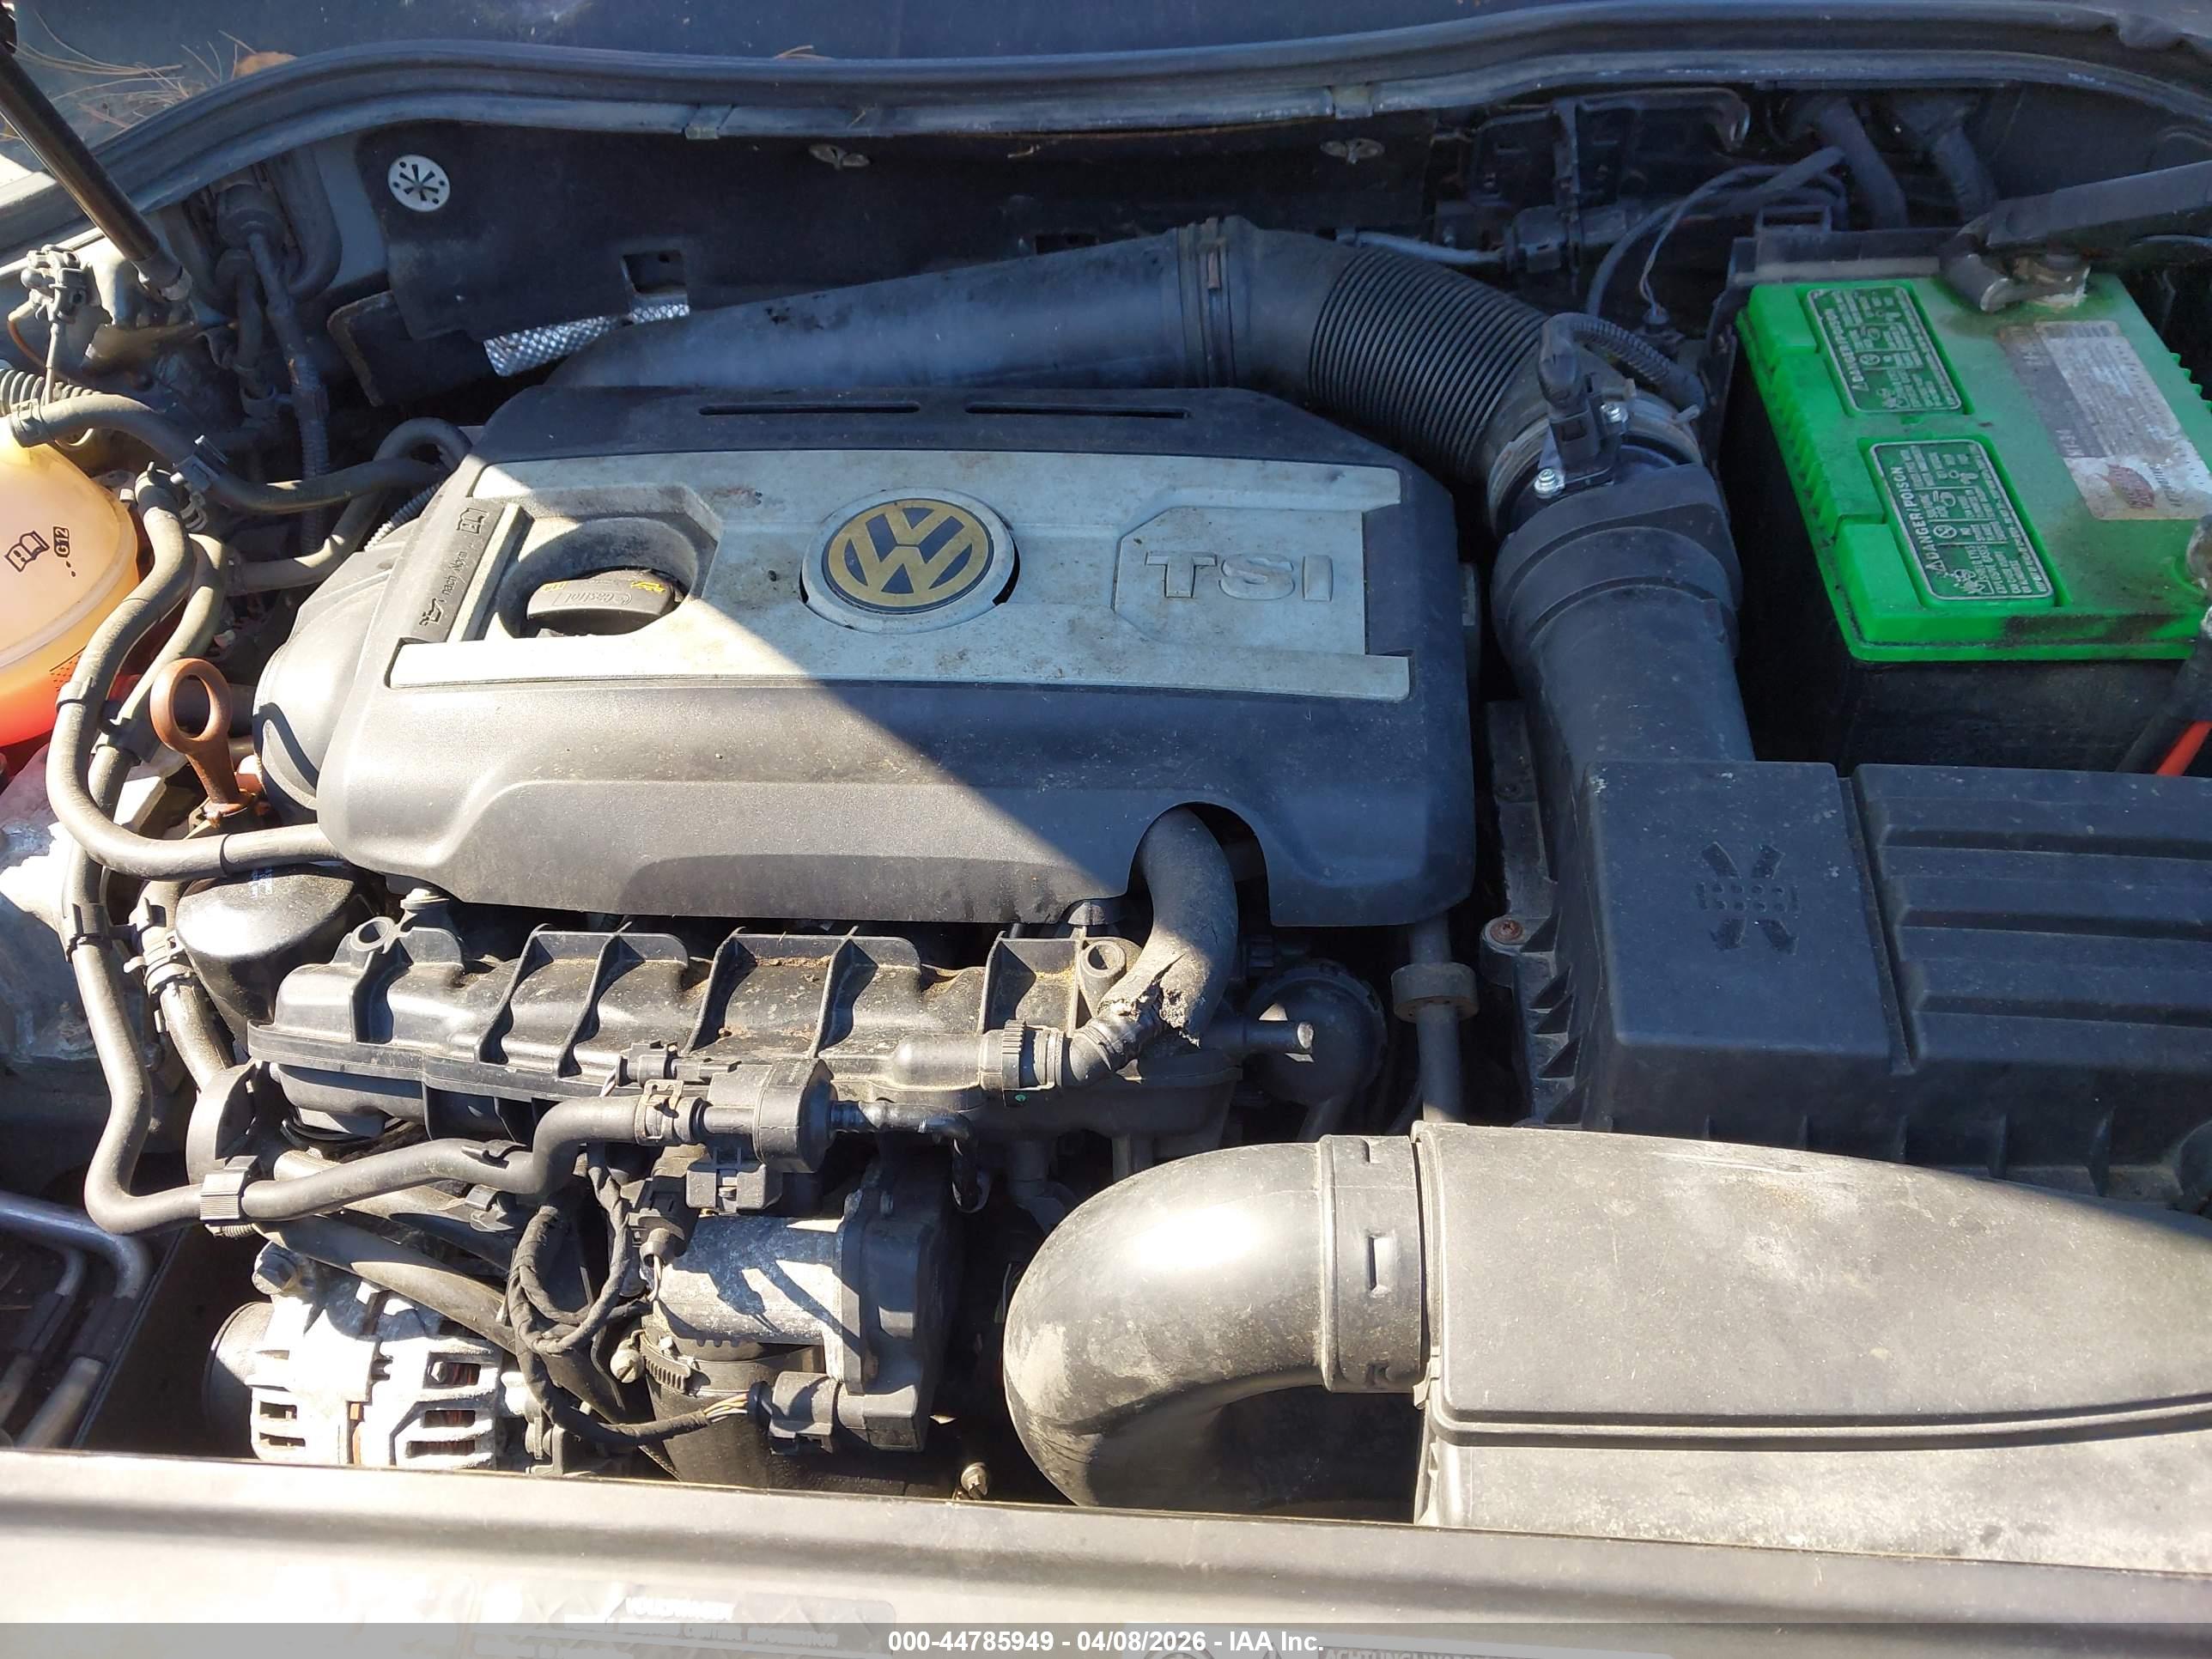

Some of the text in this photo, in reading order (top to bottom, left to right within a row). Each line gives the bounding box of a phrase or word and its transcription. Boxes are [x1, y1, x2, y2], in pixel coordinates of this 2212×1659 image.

[1891, 467, 1941, 559] DANGER/POISON
[54, 527, 69, 555] G12
[1145, 551, 1334, 601] TSI
[564, 592, 615, 606] Castrol
